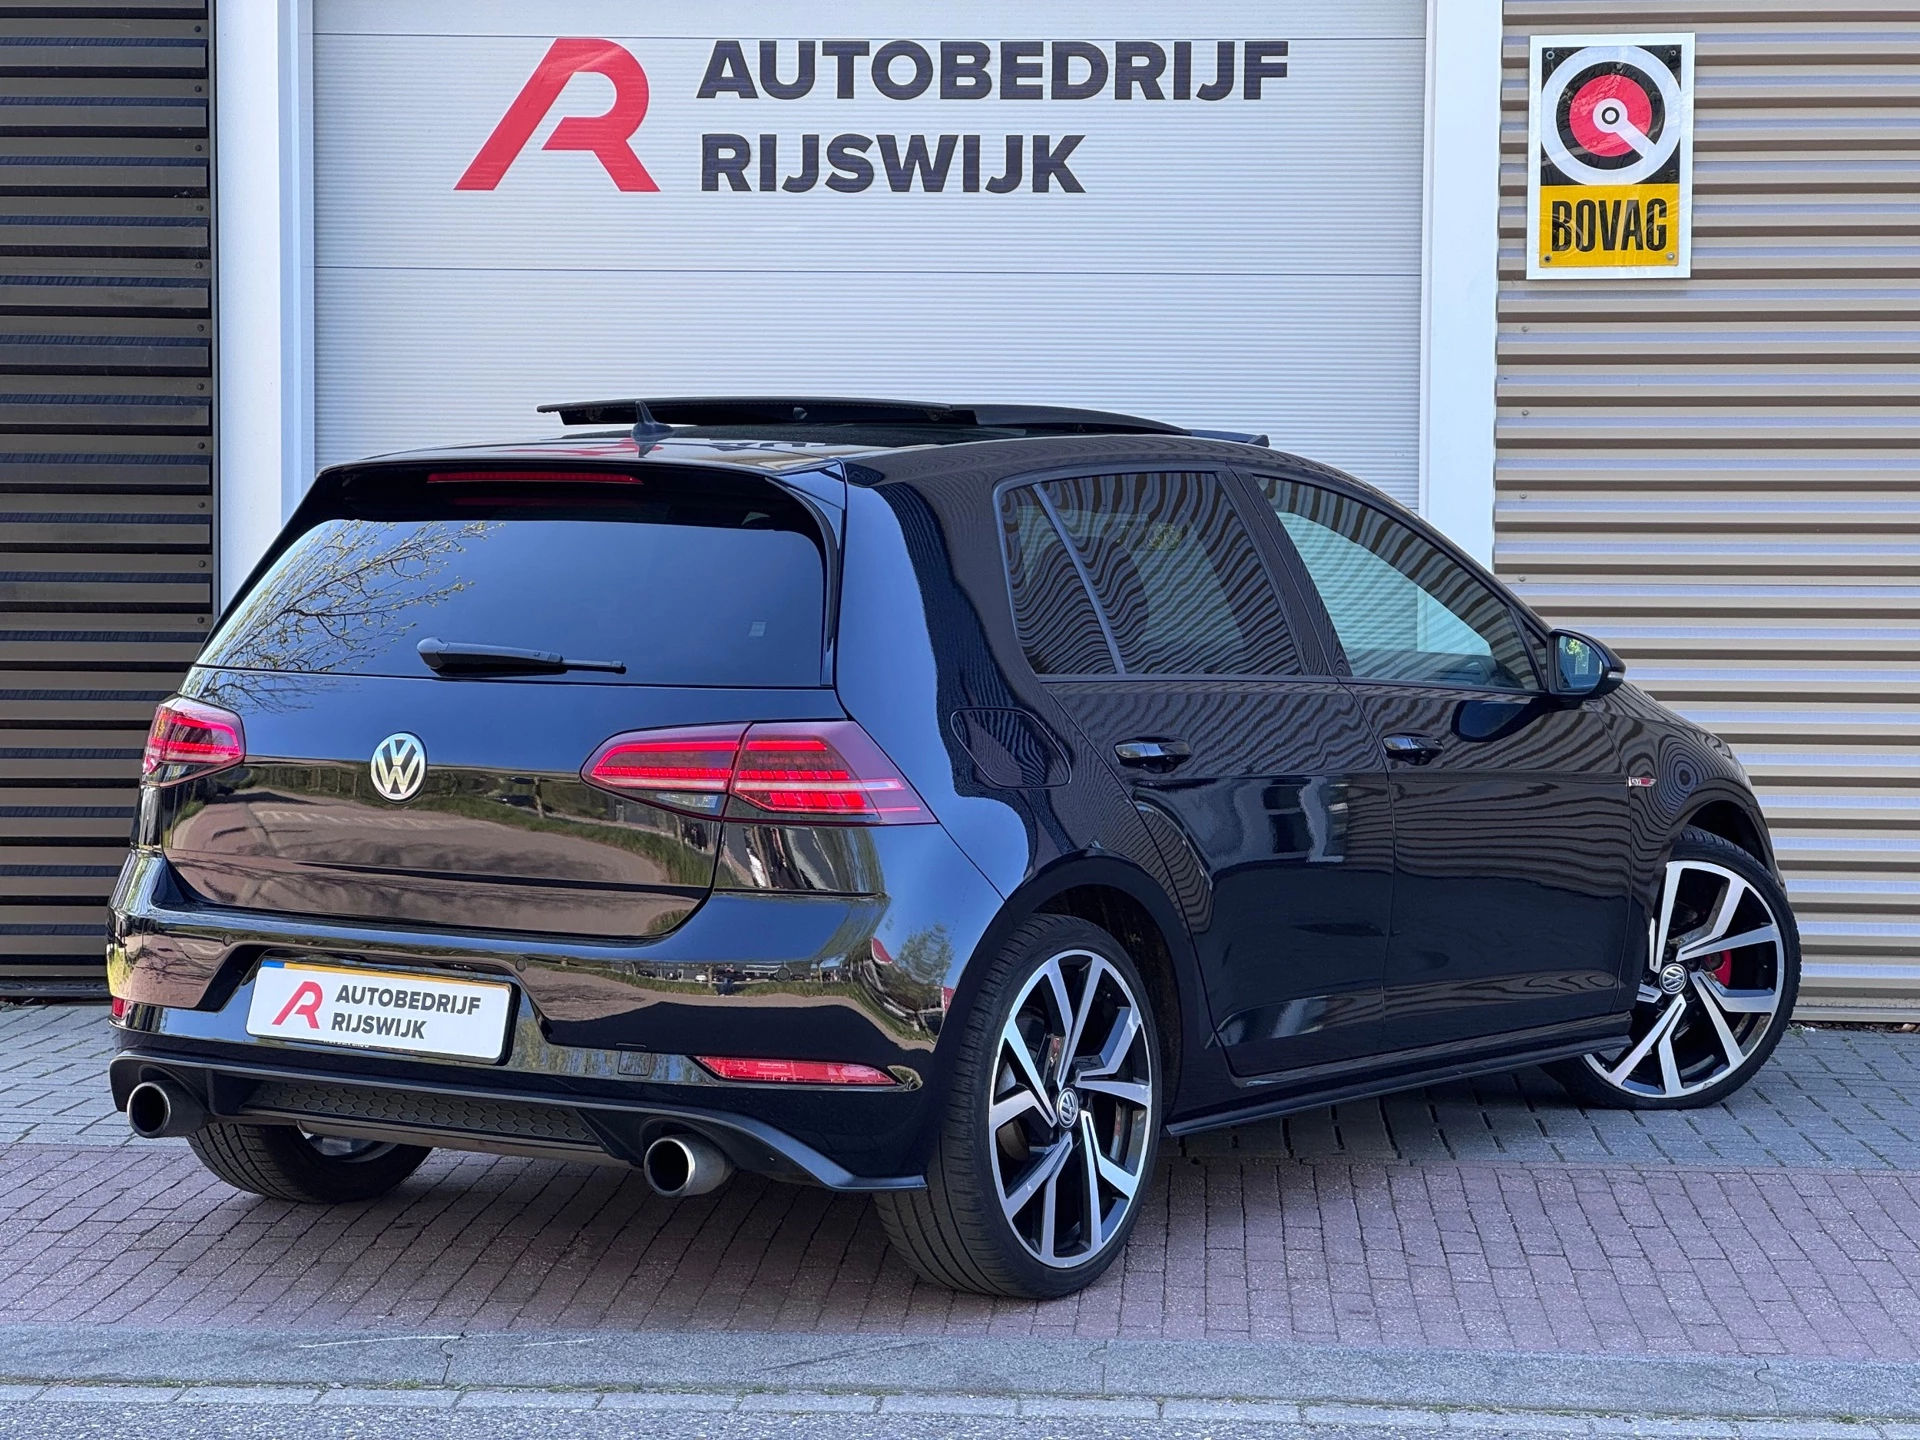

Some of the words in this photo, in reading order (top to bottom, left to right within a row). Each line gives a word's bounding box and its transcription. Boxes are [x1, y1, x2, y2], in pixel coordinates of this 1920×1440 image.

[696, 40, 1289, 101] AUTOBEDRIJF
[701, 133, 1087, 194] RIJSWIJK
[1551, 198, 1667, 253] BOVAG
[331, 1012, 427, 1040] RIJSWIJK
[335, 984, 482, 1016] AUTOBEDRIJF
